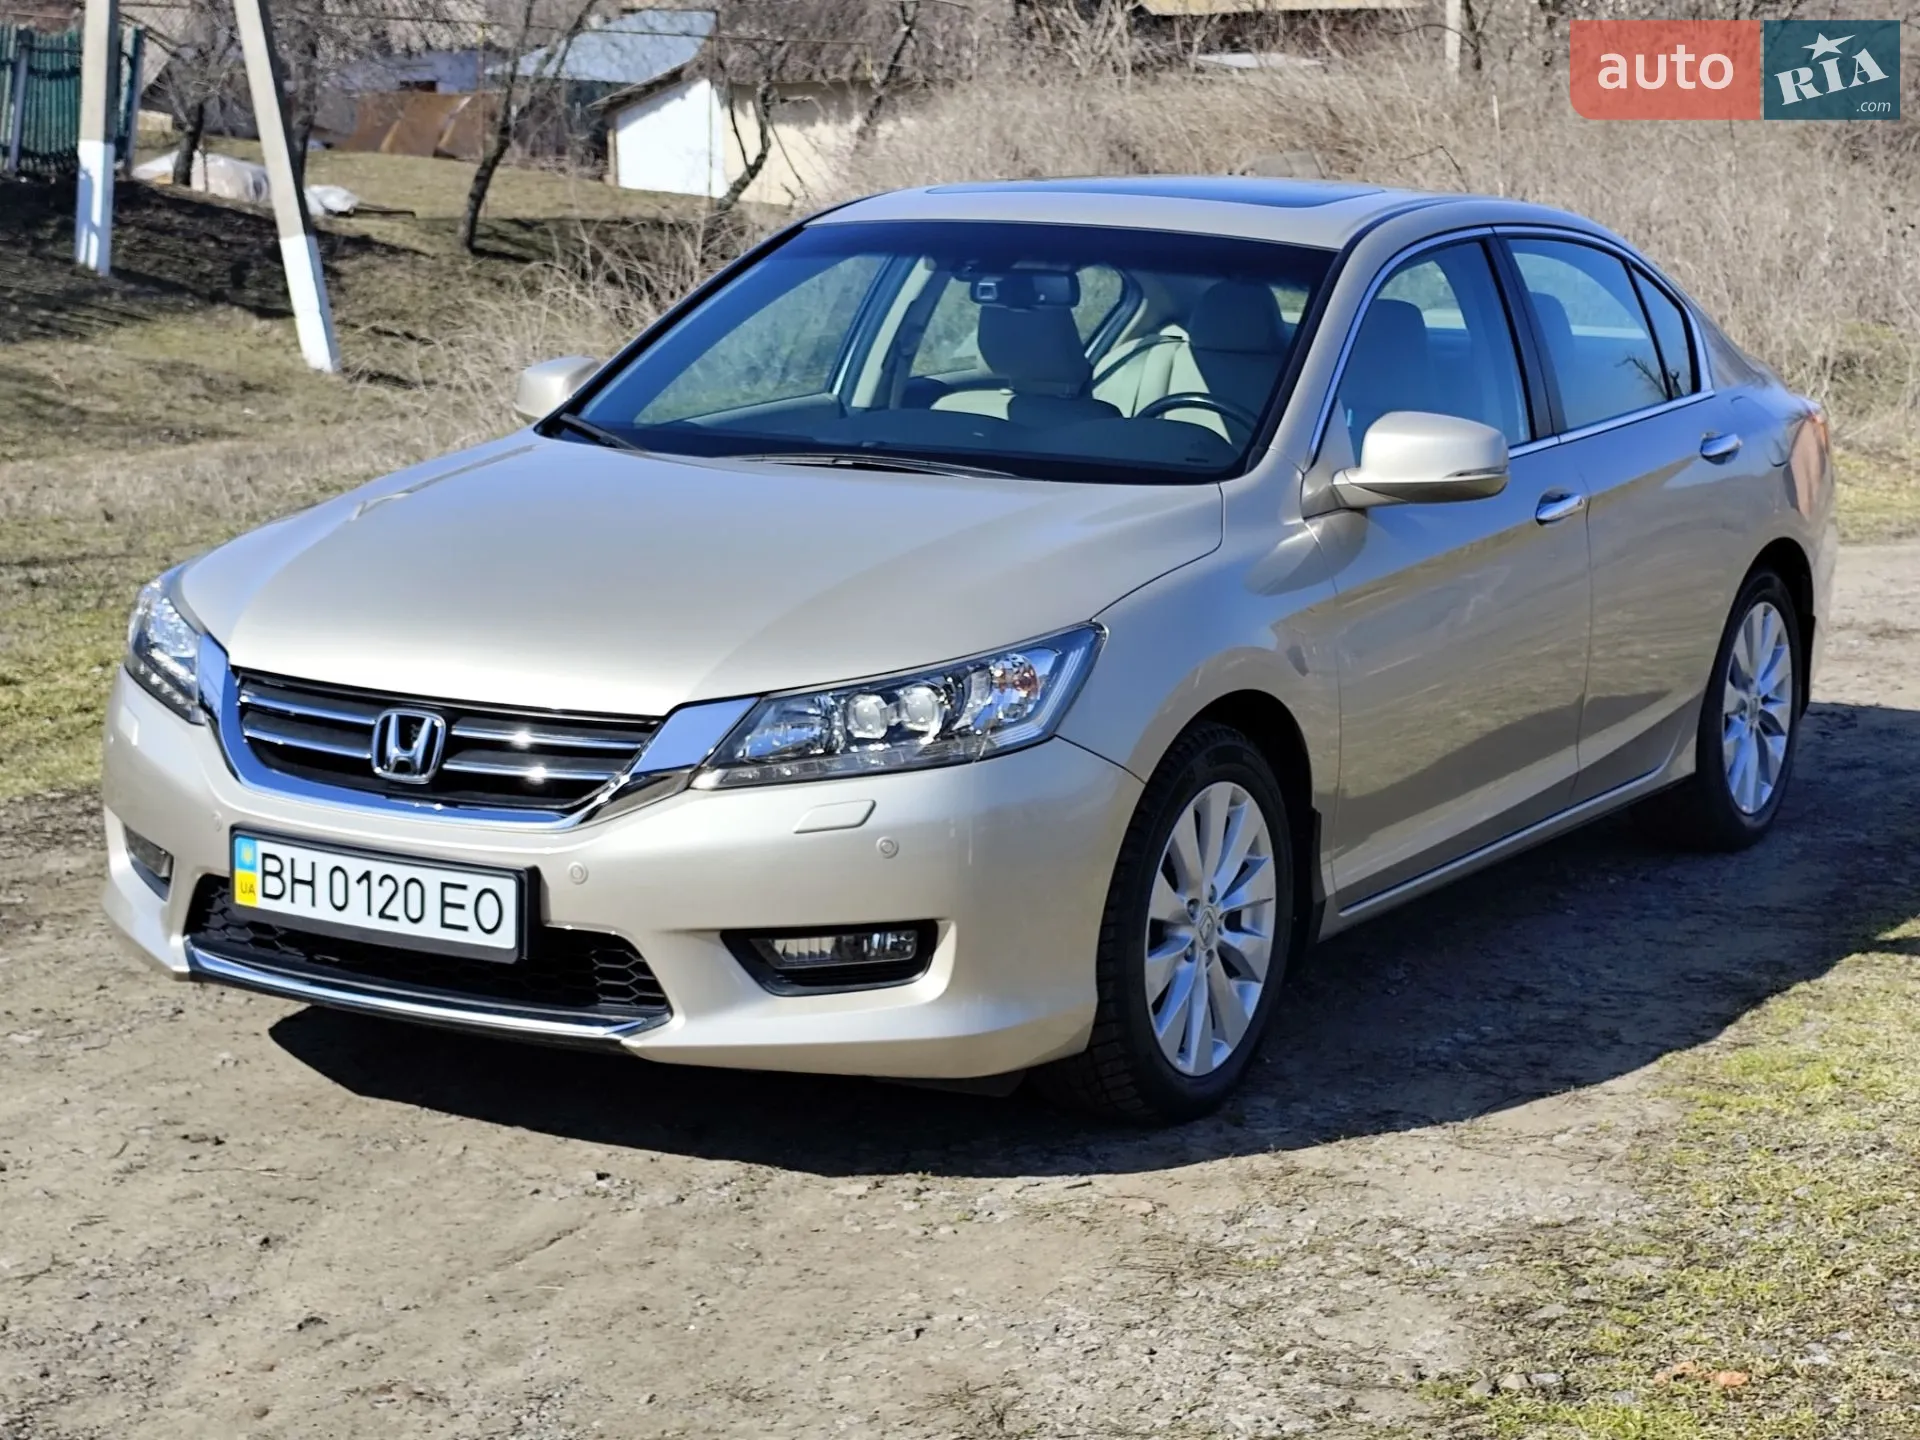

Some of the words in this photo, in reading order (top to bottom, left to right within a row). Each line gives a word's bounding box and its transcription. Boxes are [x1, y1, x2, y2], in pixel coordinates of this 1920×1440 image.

[240, 882, 256, 897] UA
[261, 852, 316, 907] BH
[329, 865, 425, 924] 0120
[440, 881, 503, 935] EO
